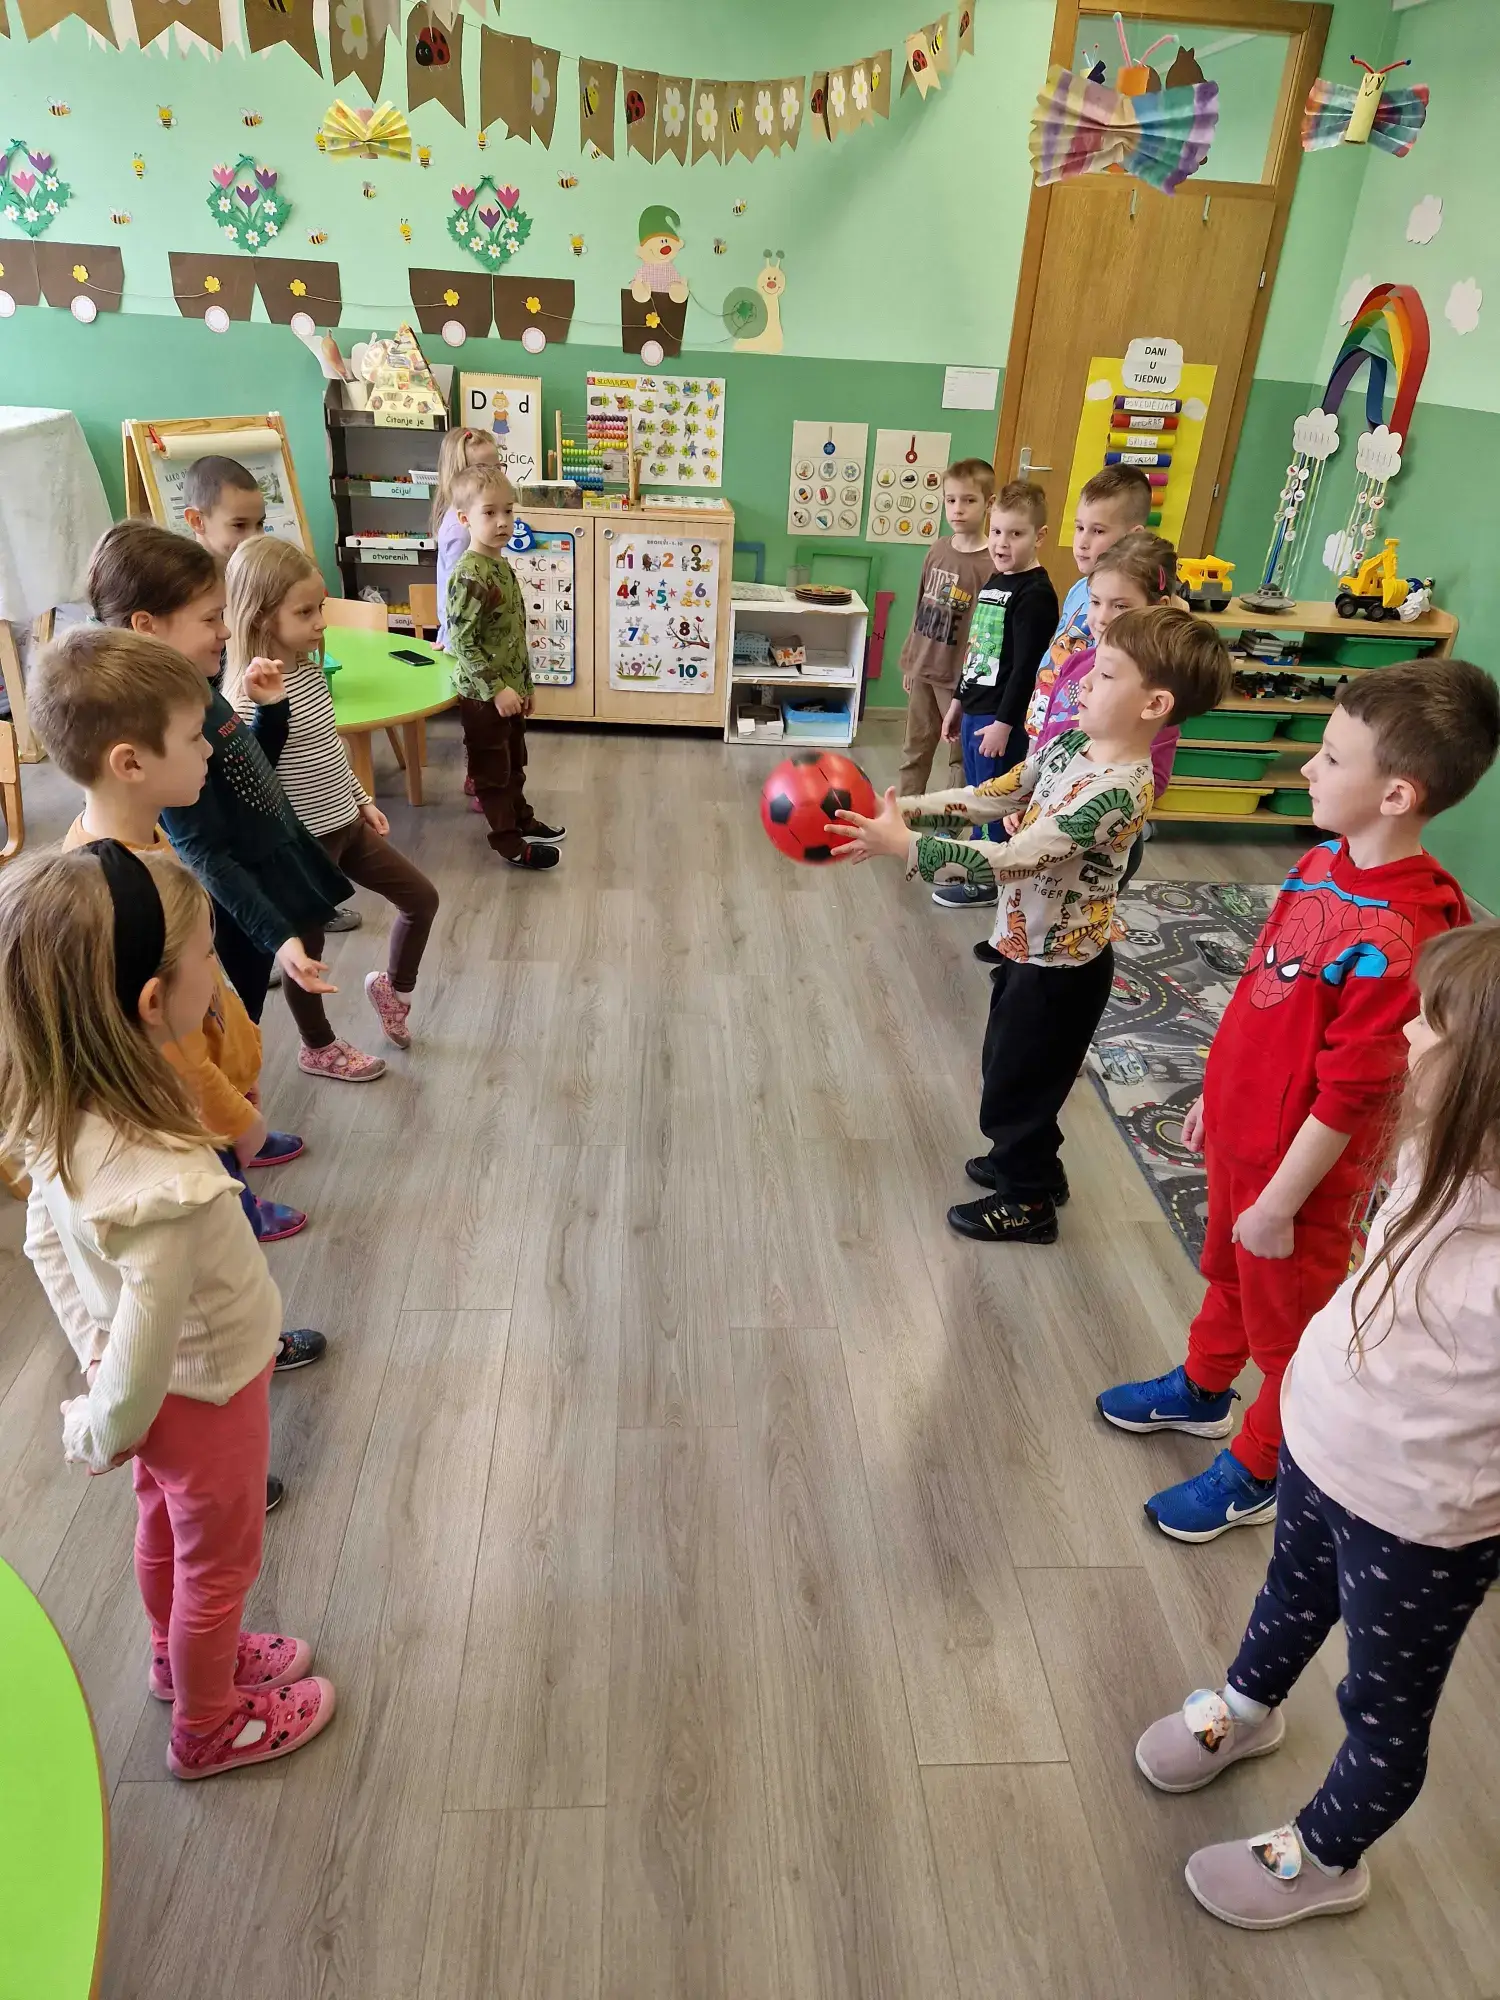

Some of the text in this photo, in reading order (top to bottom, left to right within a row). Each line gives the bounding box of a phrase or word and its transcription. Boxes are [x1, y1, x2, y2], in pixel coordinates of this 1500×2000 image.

[1144, 346, 1167, 356] DANI
[1149, 361, 1157, 370] U
[1134, 373, 1167, 385] TJEDNU
[471, 390, 529, 414] D d
[385, 413, 425, 427] Čitanje je
[372, 553, 409, 561] otvorenih
[537, 555, 547, 572] Č
[627, 552, 701, 572] 1 2 3
[539, 579, 546, 591] E
[557, 579, 565, 592] F
[616, 582, 706, 604] 4 5 6
[555, 599, 564, 611] K
[627, 626, 639, 642] 7
[679, 621, 690, 636] 8
[540, 636, 547, 649] S
[631, 662, 698, 678] 9 10
[1034, 873, 1063, 886] APPY
[1033, 884, 1063, 899] TIGER
[1125, 931, 1159, 945] 95
[1002, 1216, 1030, 1230] FILA
